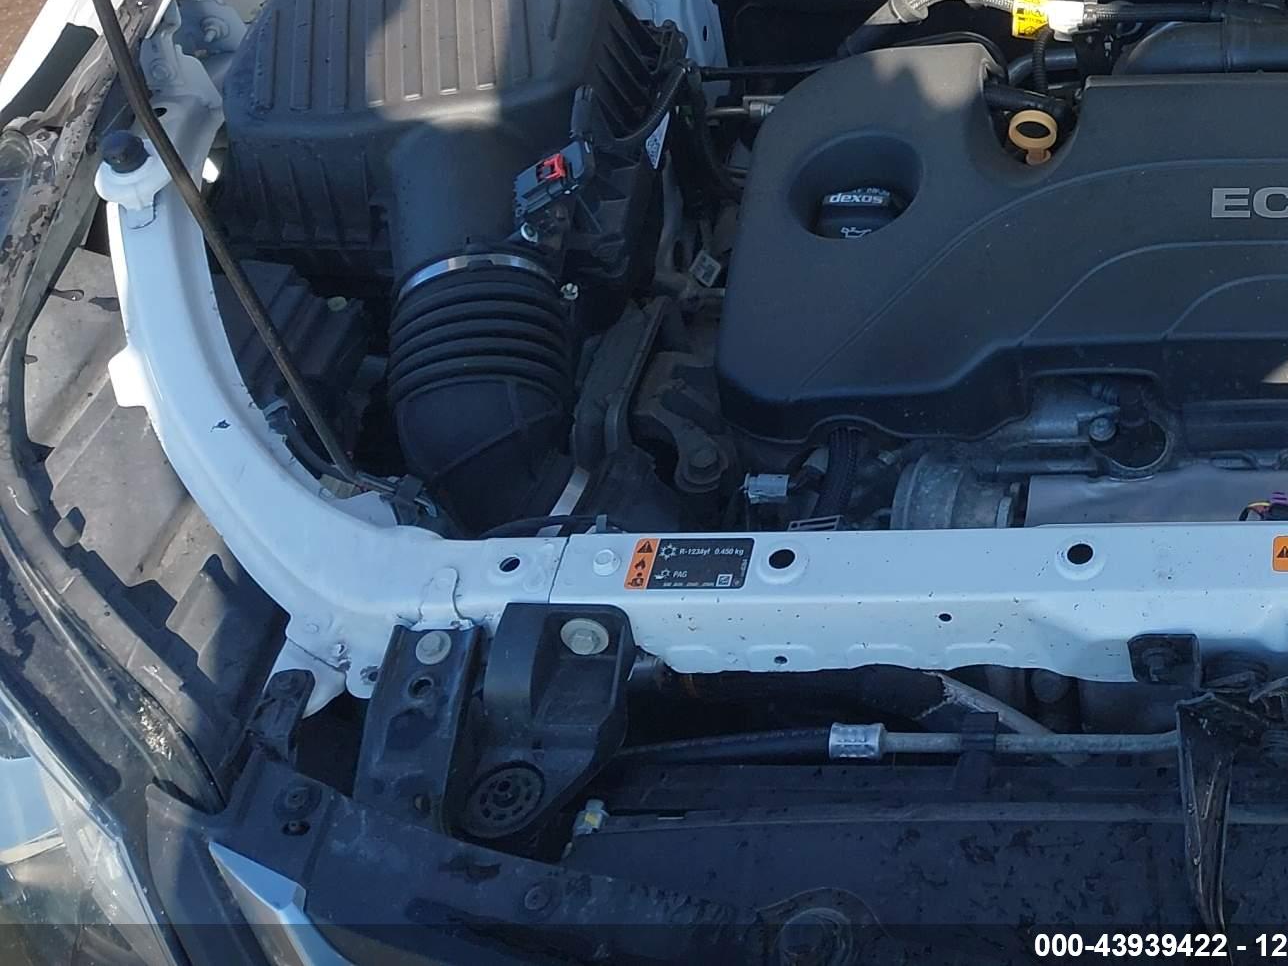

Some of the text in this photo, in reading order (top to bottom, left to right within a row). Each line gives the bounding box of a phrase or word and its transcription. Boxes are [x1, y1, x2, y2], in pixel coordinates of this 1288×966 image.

[829, 192, 883, 204] dexos
[735, 548, 744, 556] kg
[672, 570, 688, 578] PAG
